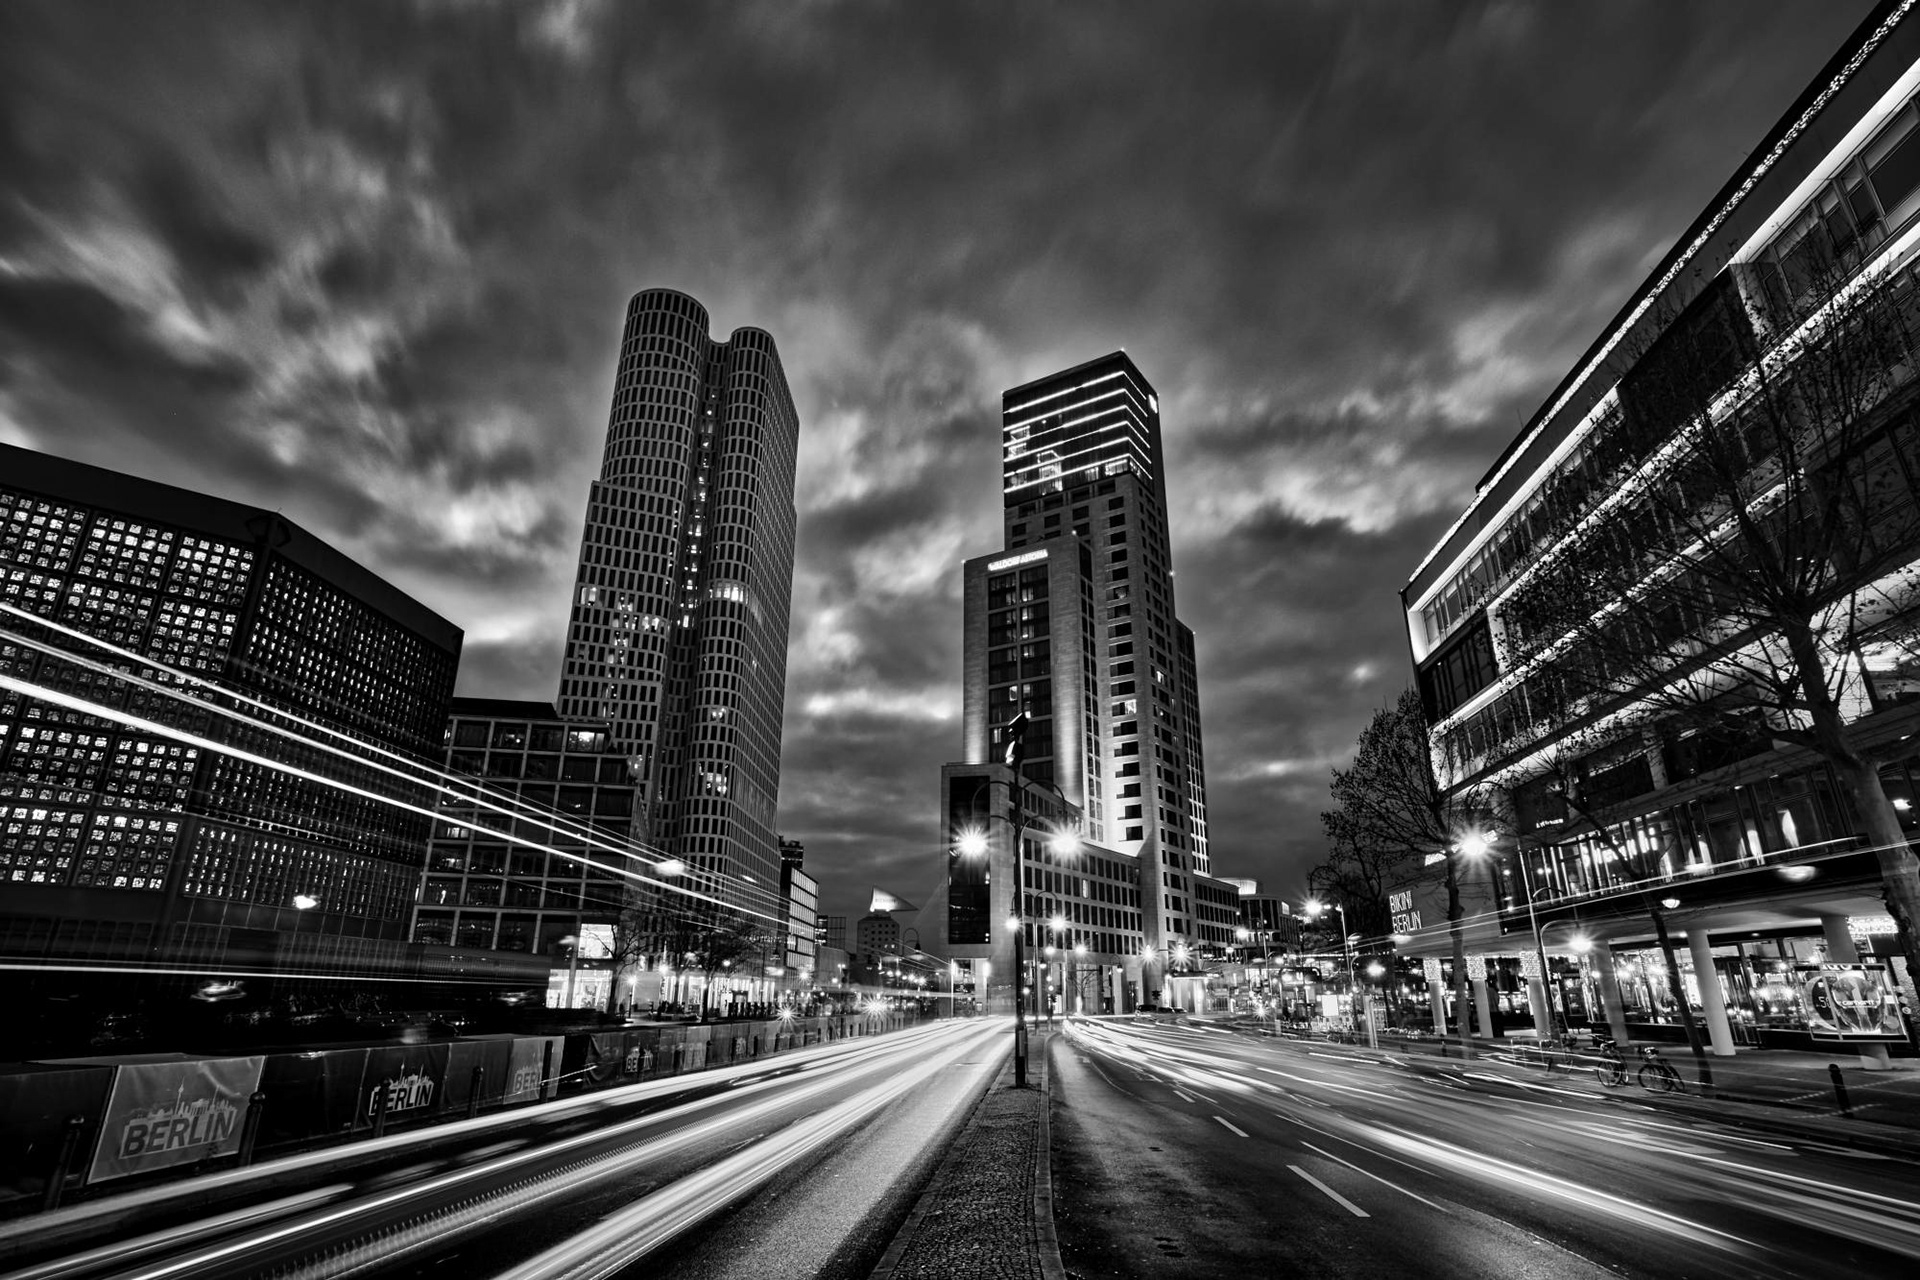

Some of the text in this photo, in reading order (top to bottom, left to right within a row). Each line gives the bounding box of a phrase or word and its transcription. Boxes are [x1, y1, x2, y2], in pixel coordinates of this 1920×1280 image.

[1390, 891, 1412, 913] BIKINI
[1392, 911, 1422, 933] BERLIN
[121, 1109, 236, 1158] BERLIN
